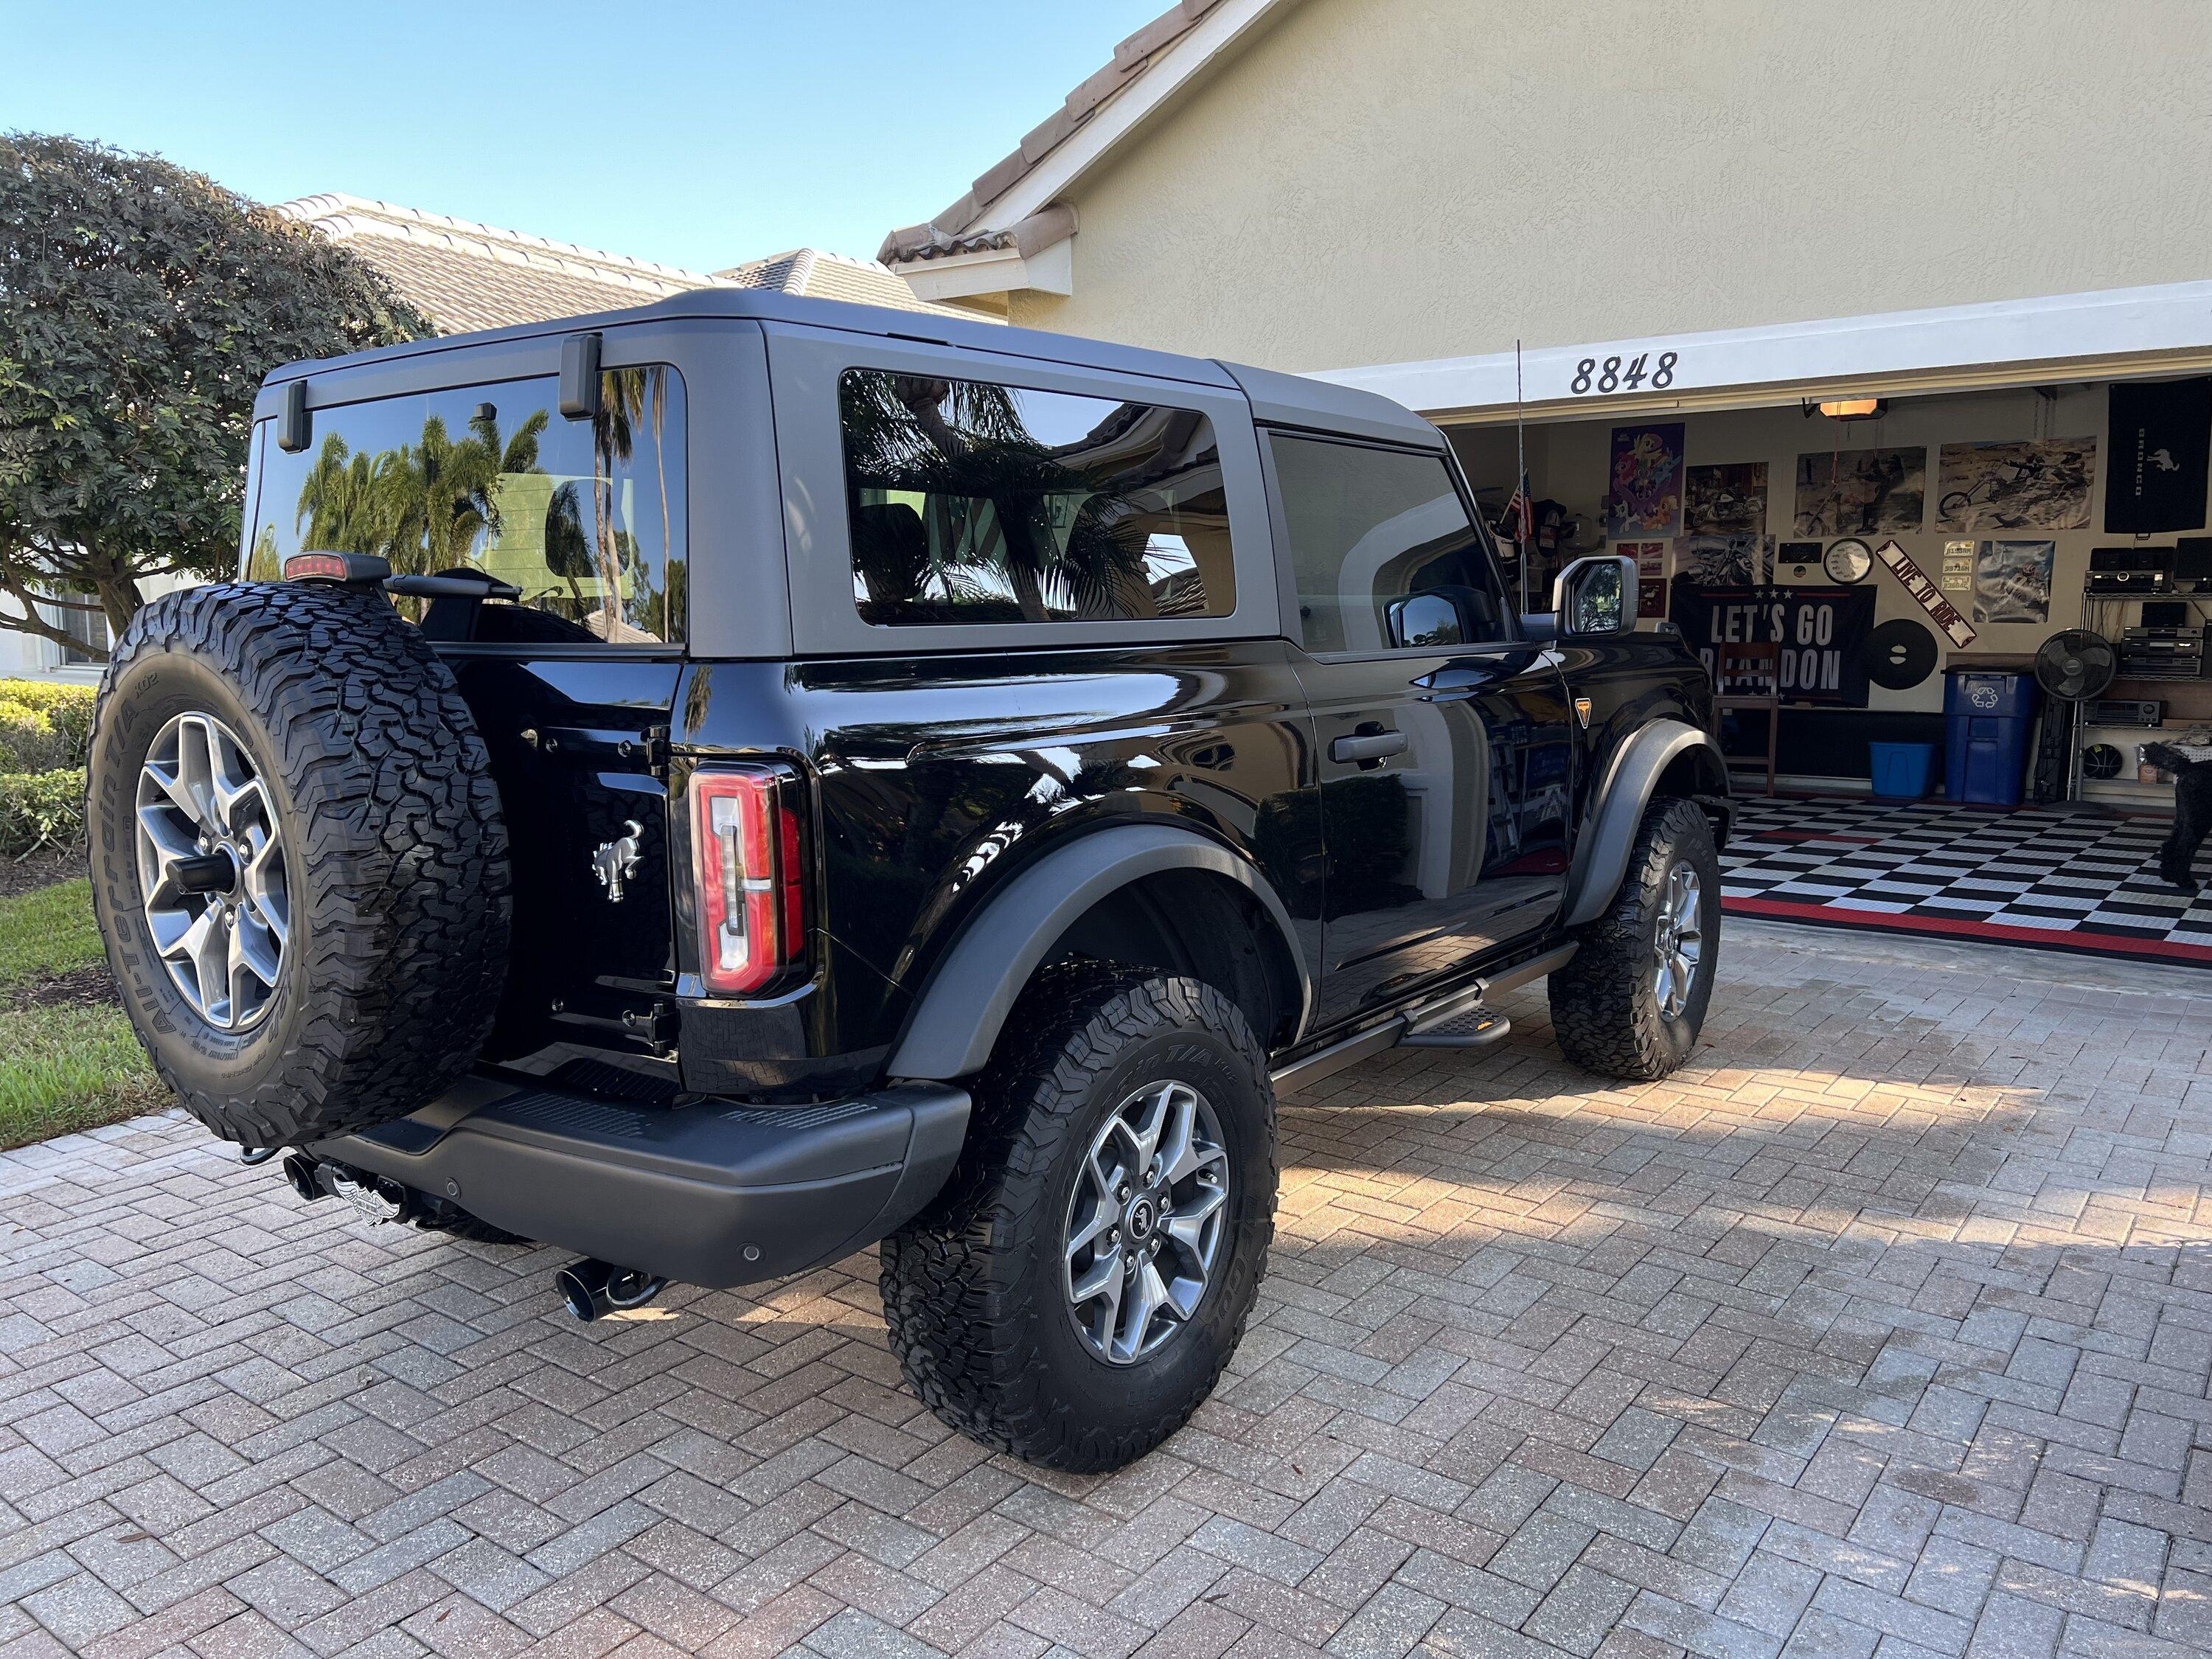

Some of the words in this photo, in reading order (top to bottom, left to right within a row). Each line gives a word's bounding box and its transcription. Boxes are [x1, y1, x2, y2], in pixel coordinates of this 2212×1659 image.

[1571, 352, 1677, 394] 8848
[2135, 428, 2145, 496] BRONCO
[1711, 603, 1785, 643] LET'S
[1797, 604, 1833, 646] GO
[1891, 557, 1922, 586] LIVE
[1916, 582, 1936, 603] TO
[1930, 601, 1961, 631] RIDE
[105, 698, 139, 768] T/A
[99, 773, 177, 1033] All-Terrain
[1165, 1044, 1214, 1067] T/A
